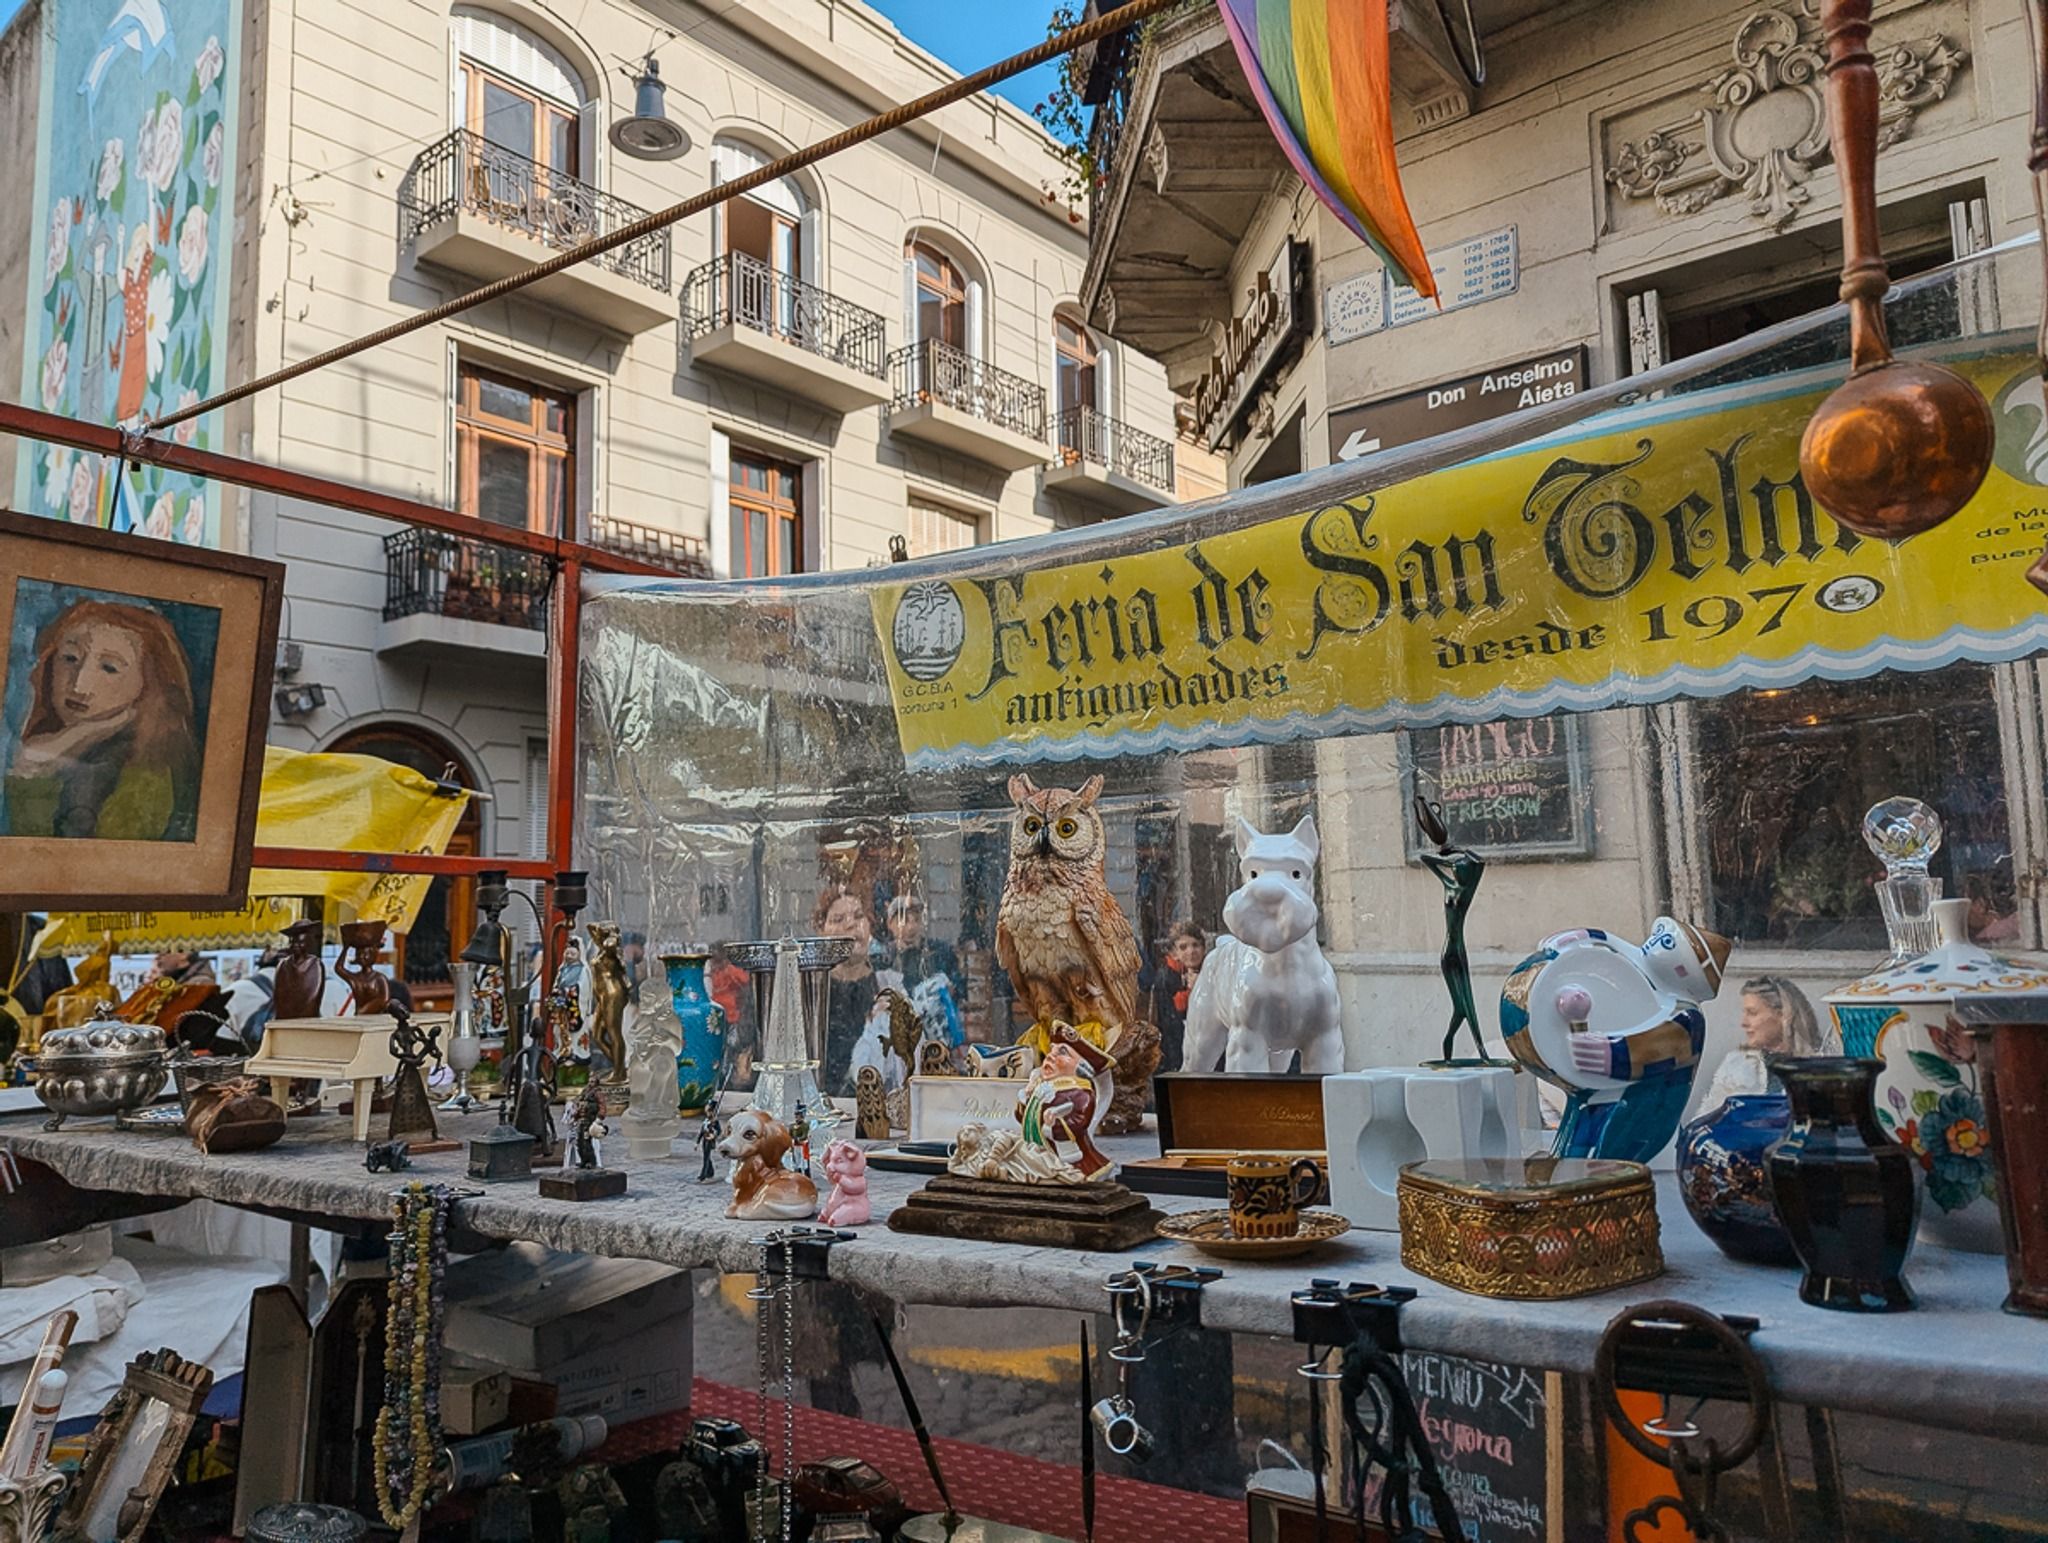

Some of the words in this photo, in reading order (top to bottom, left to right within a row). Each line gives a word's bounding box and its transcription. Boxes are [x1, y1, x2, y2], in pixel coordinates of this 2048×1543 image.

[1428, 387, 1466, 409] Don
[1480, 358, 1574, 396] Anselmo
[1517, 380, 1576, 409] Aieta
[1976, 528, 2010, 538] de
[2021, 521, 2045, 531] la
[965, 563, 1165, 700] Feria
[1184, 543, 1275, 650] de
[1296, 495, 1505, 660] San
[1522, 432, 1915, 599] Telm
[1005, 655, 1290, 727] antiguedades
[1432, 621, 1606, 669] desde
